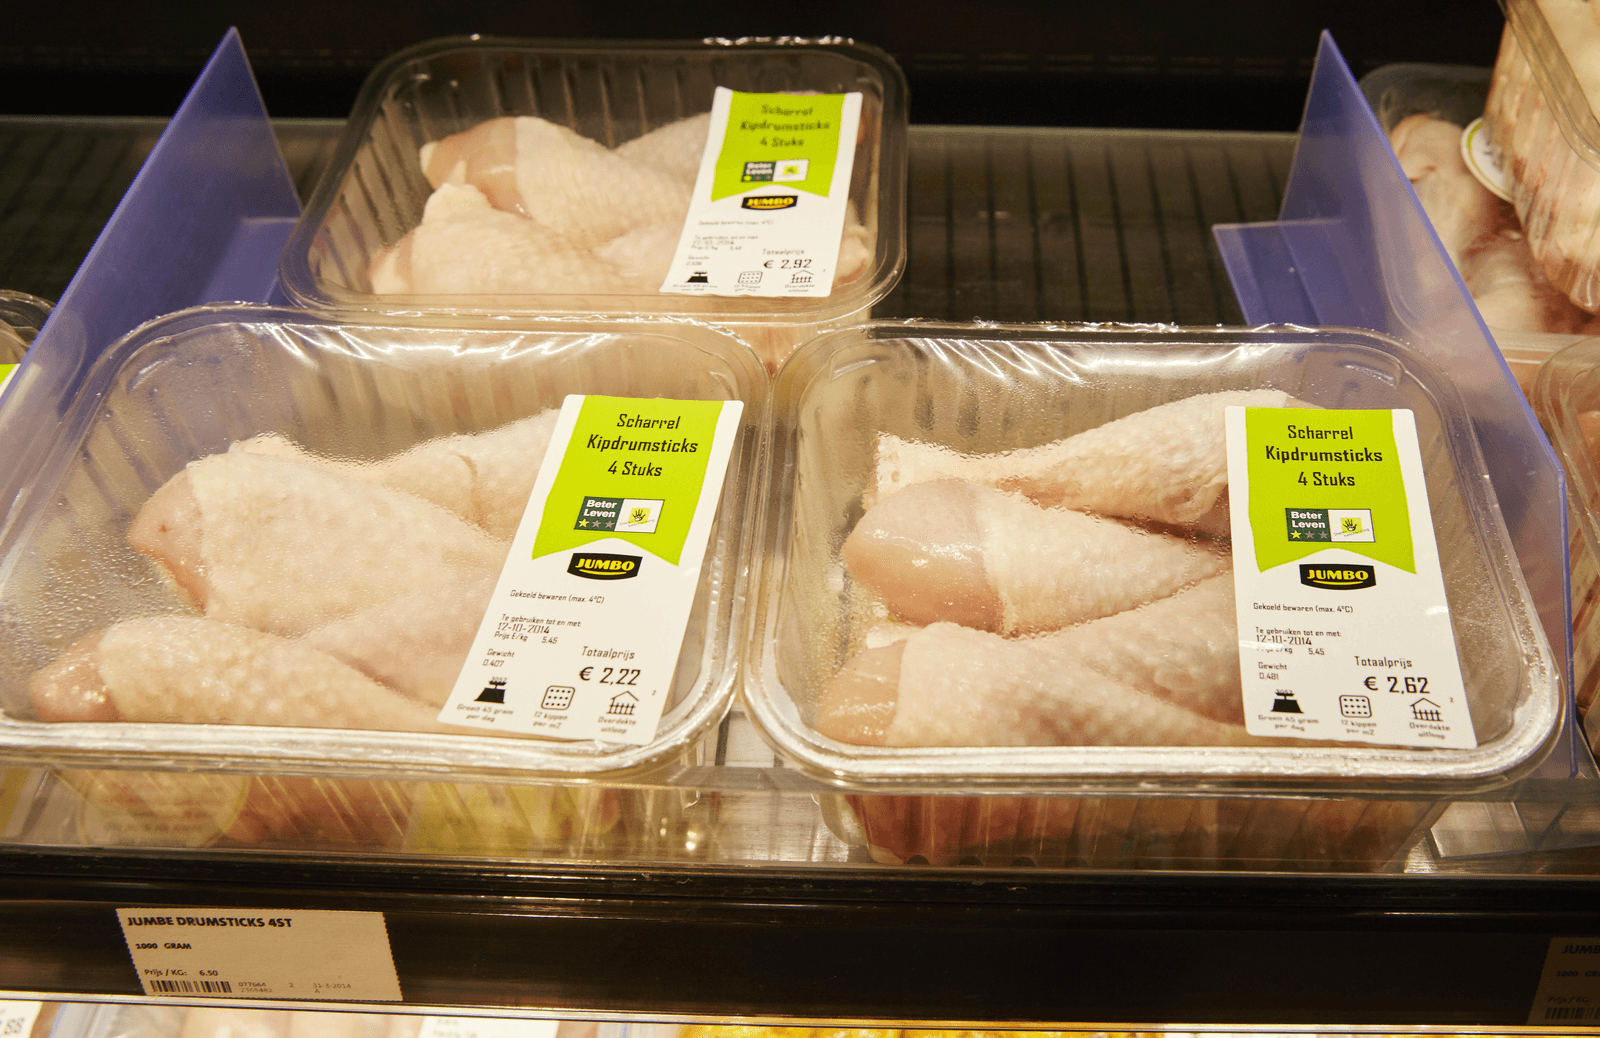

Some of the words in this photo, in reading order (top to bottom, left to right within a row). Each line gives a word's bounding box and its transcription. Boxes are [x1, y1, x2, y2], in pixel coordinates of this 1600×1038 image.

[760, 136, 767, 147] 4
[771, 136, 804, 147] Stuks
[747, 197, 794, 207] JUMBO
[617, 413, 681, 431] Scharrel
[1287, 424, 1354, 440] Scharrel
[587, 434, 699, 454] Kipdrumsticks
[1265, 445, 1383, 463] Kipdrumsticks
[608, 461, 618, 475] 4
[622, 461, 663, 478] Stuks
[1297, 471, 1308, 486] 4
[1313, 471, 1356, 487] Stuks
[586, 499, 617, 509] Beter
[583, 508, 617, 519] Leven
[1290, 510, 1322, 520] Beter
[1291, 519, 1326, 529] Leven
[574, 558, 635, 572] JUMBO
[1307, 569, 1369, 581] JUMBO
[510, 589, 537, 599] Gekoeld
[538, 592, 567, 602] bewaren
[1253, 602, 1281, 612] Gekoeld
[1282, 604, 1314, 613] bewaren
[501, 613, 509, 622] Te
[510, 615, 544, 626] gebruiken
[546, 617, 556, 625] tot
[498, 621, 550, 634] 12-10-2014
[1255, 626, 1264, 635] Te
[1266, 627, 1302, 637] gebruiken
[1303, 628, 1314, 637] tot
[494, 631, 510, 641] Prijs
[1255, 634, 1312, 646] 12-10-2014
[487, 648, 514, 659] Gewicht
[582, 645, 635, 660] Totaalprijs
[1258, 661, 1288, 671] Gewicht
[1354, 655, 1413, 669] Totaalprijs
[579, 666, 594, 681] €
[1363, 676, 1379, 691] €
[1409, 721, 1451, 732] Overdekte
[127, 916, 174, 926] JUMBE
[177, 916, 266, 927] DRUMSTICKS
[268, 917, 292, 928] 4ST
[135, 942, 158, 950] 1000
[164, 942, 192, 950] GRAM
[144, 969, 163, 977] Prijs
[171, 969, 187, 977] KG:
[1548, 996, 1567, 1004] Prijs
